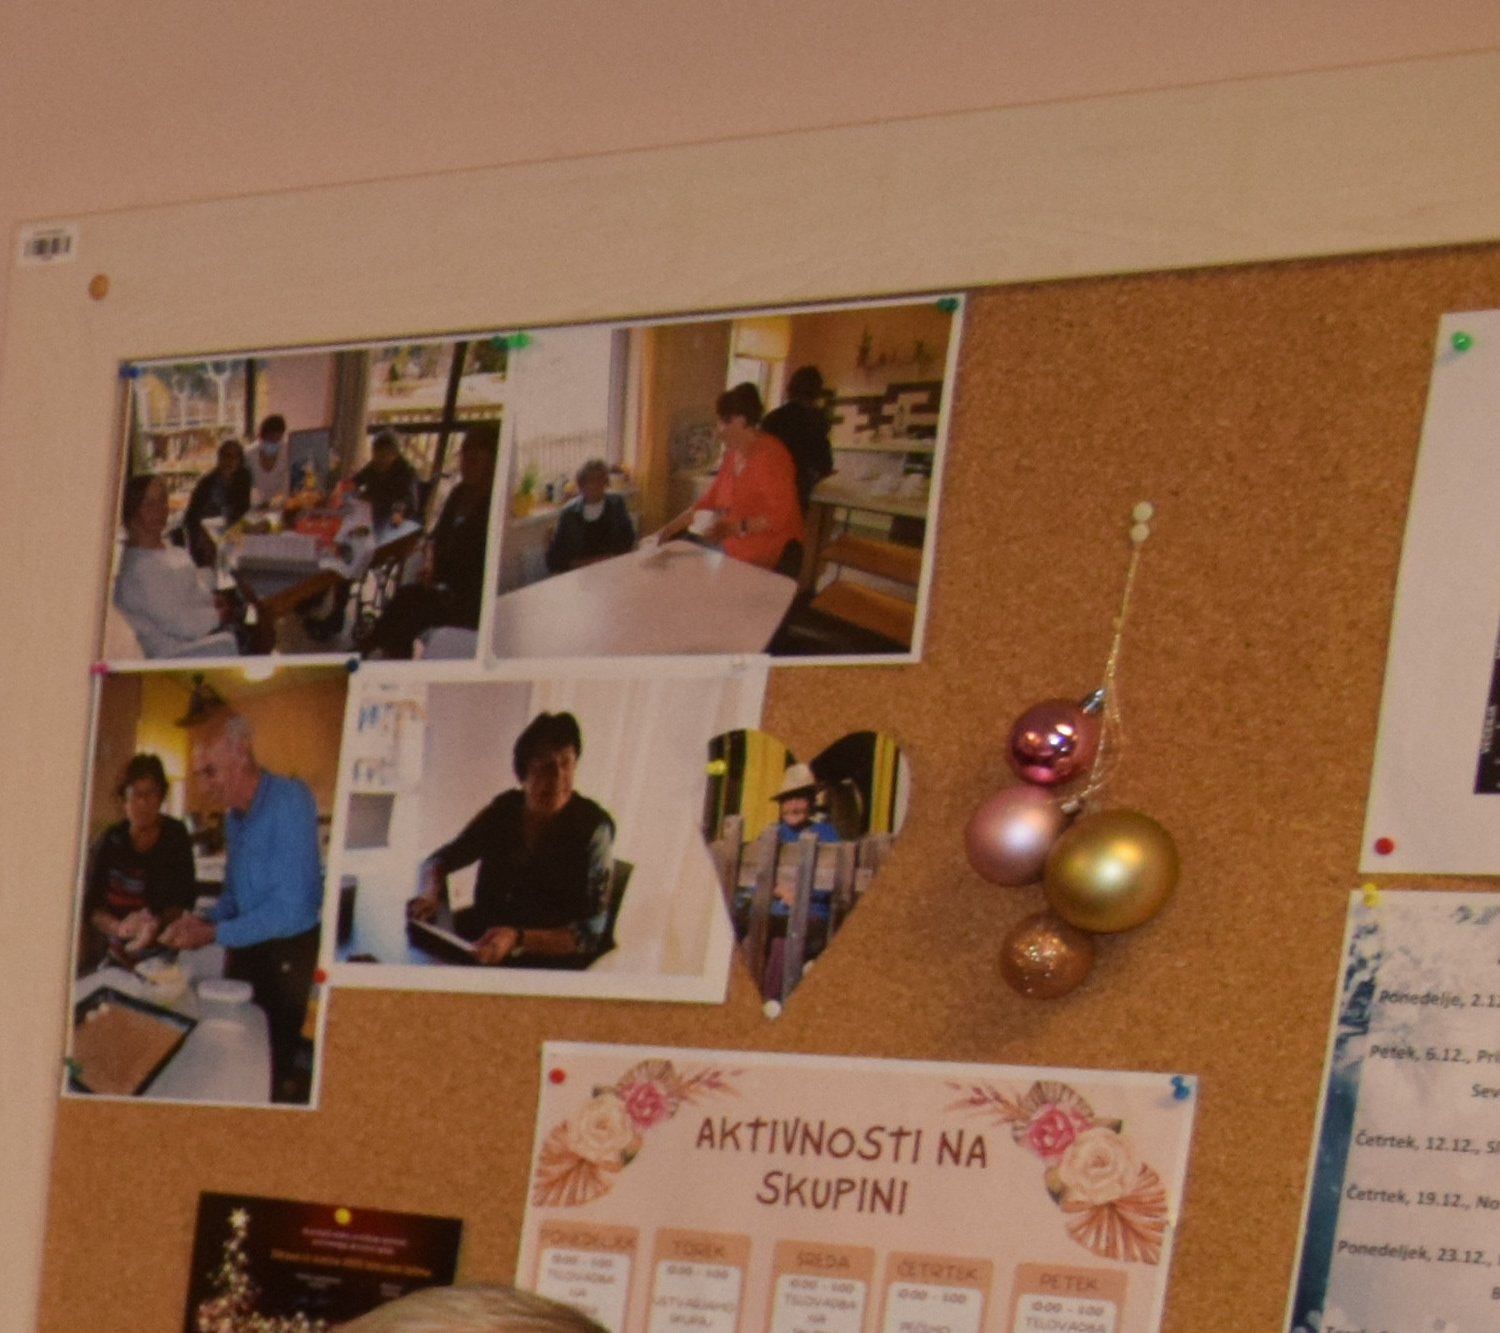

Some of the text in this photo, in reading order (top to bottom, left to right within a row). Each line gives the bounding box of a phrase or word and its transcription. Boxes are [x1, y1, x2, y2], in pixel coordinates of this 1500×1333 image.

[1369, 1044, 1420, 1062] Petek,
[696, 1116, 988, 1170] AKTIVNOSTI NA
[1356, 1129, 1420, 1151] Četrtek,
[756, 1171, 910, 1216] SKUPINI
[1347, 1183, 1410, 1205] Četrtek,
[672, 1239, 727, 1258] TOREK
[1338, 1240, 1431, 1261] Ponedeljek,
[797, 1250, 850, 1270] SREDA
[1039, 1272, 1098, 1292] PETEK
